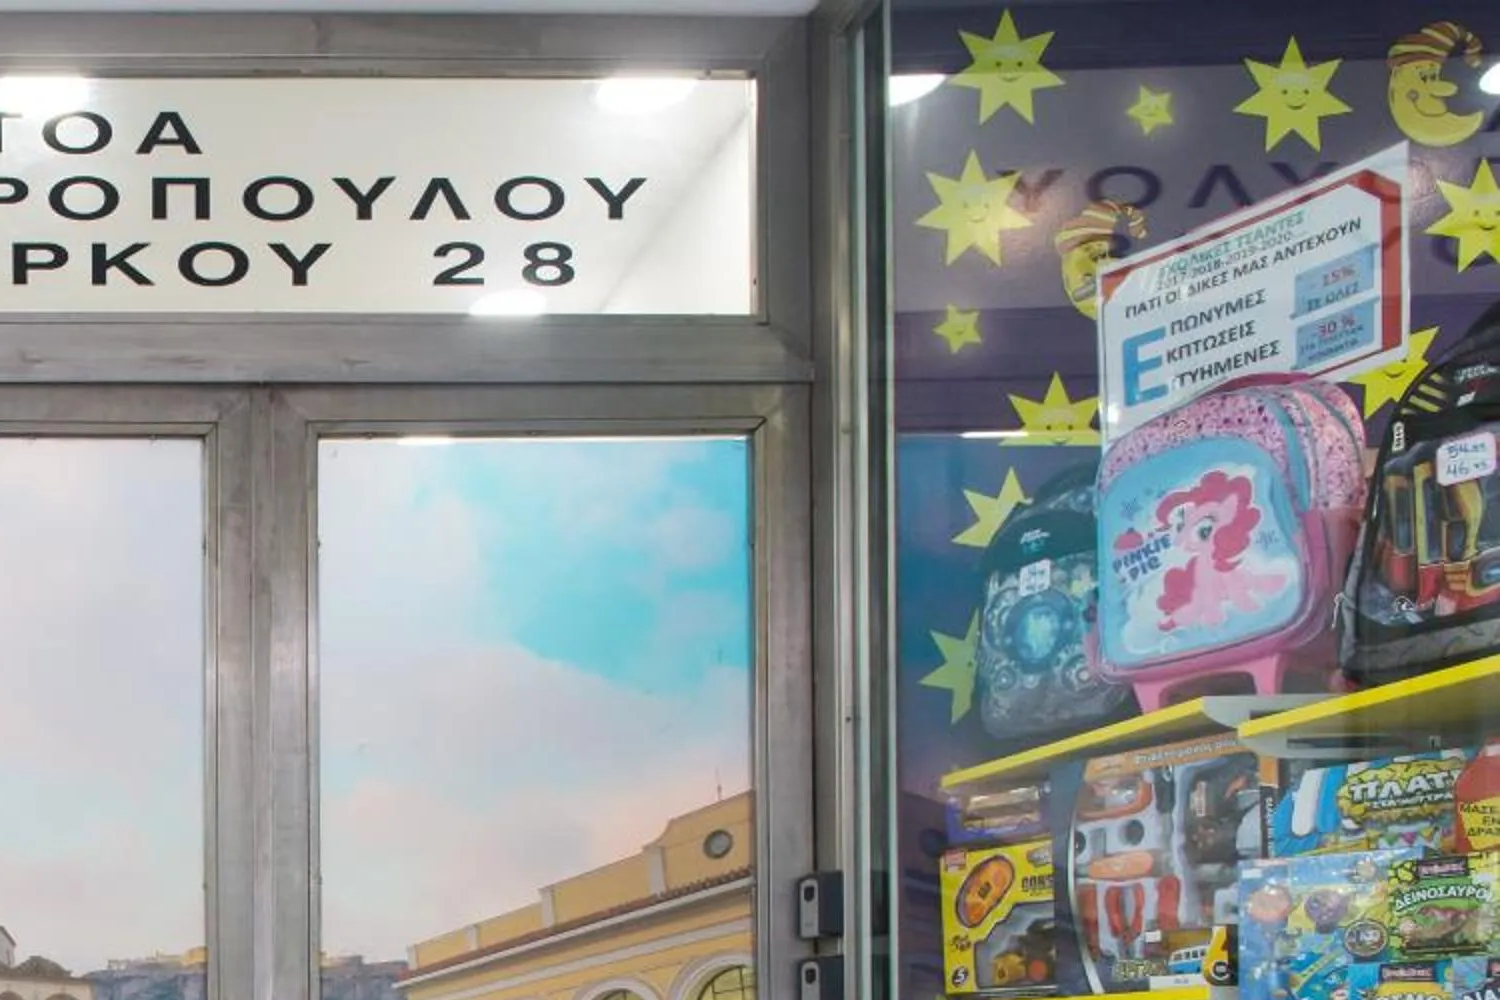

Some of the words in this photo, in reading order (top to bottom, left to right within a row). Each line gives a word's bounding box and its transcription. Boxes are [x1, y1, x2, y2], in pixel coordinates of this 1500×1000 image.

[432, 241, 576, 287] 28
[1232, 255, 1269, 280] ΜΑΣ
[1272, 216, 1362, 265] ΑΝΤΕΧΟΥΝ
